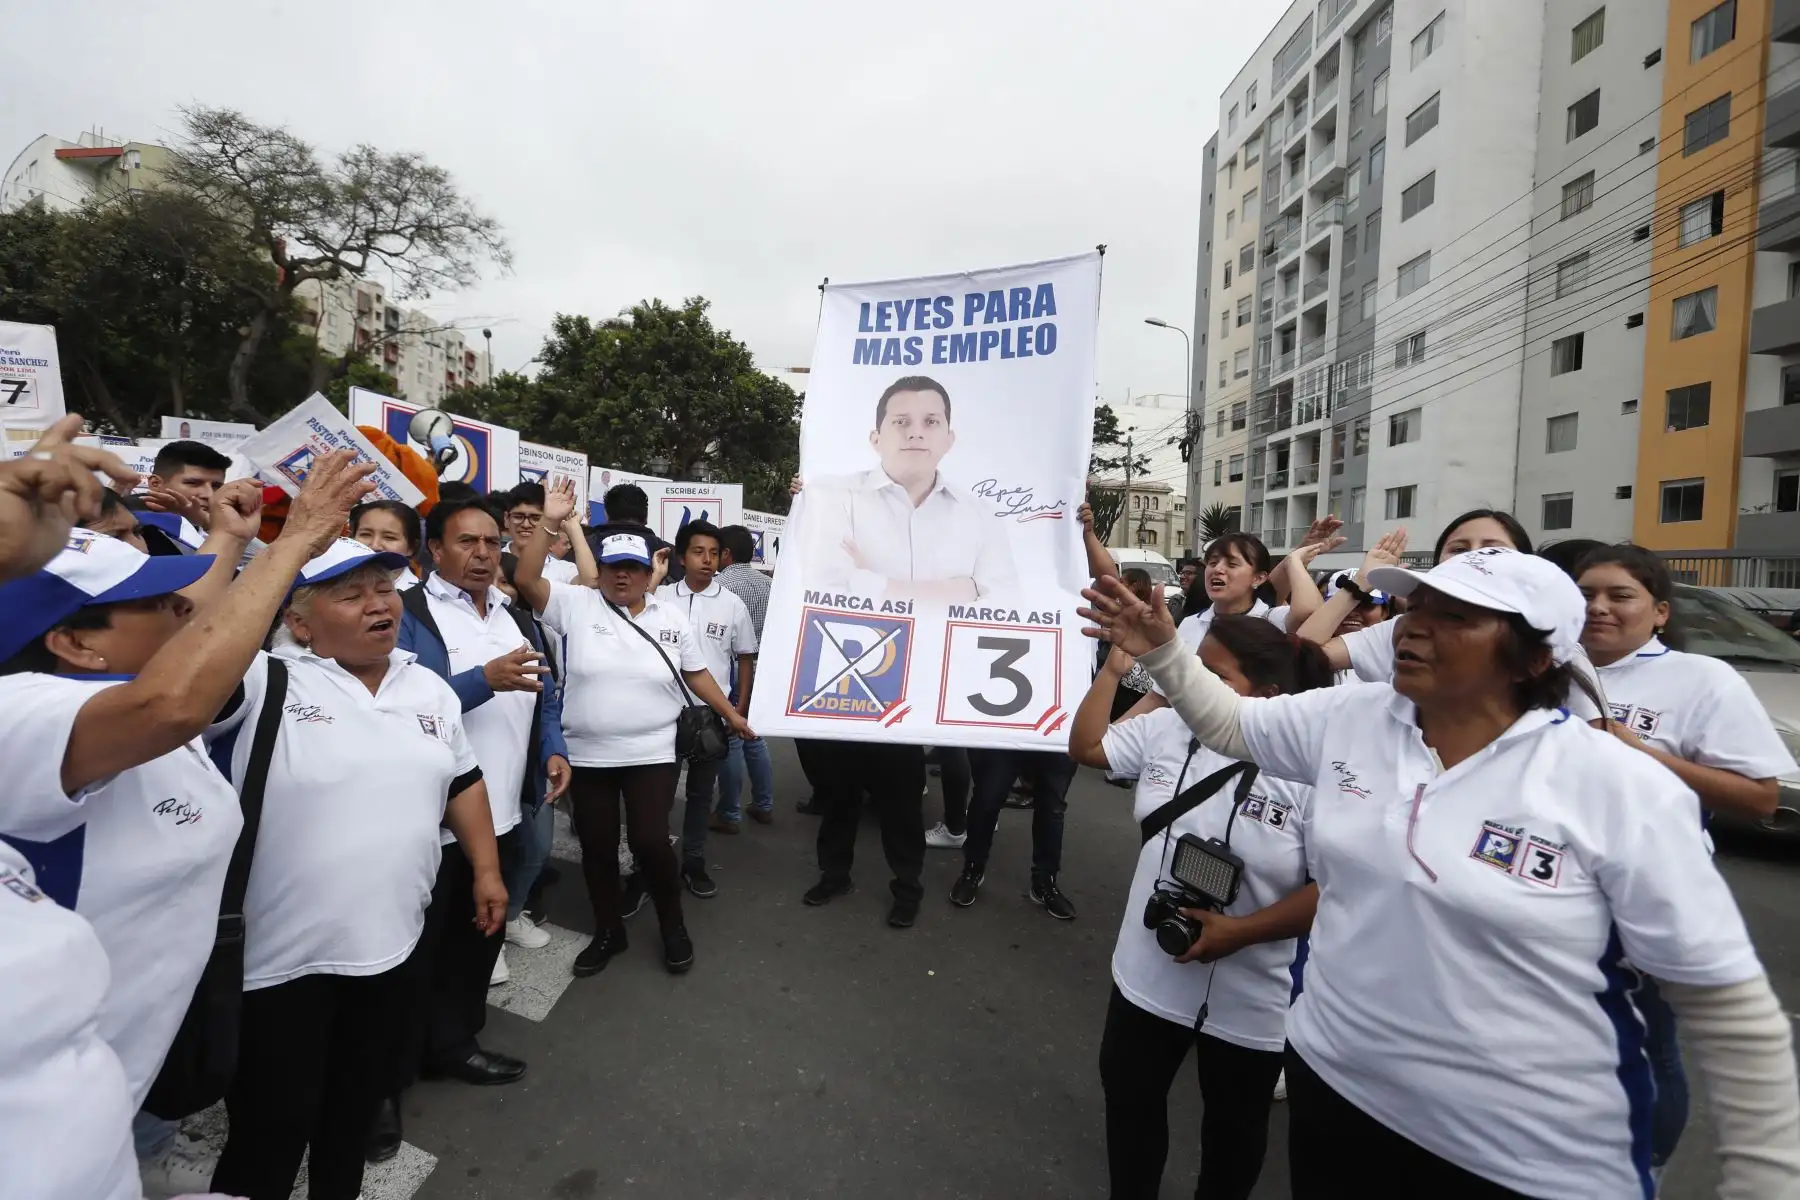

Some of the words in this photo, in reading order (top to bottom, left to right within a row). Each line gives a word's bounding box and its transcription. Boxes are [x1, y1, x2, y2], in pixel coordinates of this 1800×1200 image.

[858, 296, 954, 333] LEYES
[963, 283, 1057, 326] PARA
[853, 336, 924, 366] MAS
[931, 322, 1058, 364] EMPLEO
[8, 357, 49, 368] SANCHEZ
[0, 379, 31, 405] 7
[555, 454, 584, 467] GUPIOC
[665, 487, 697, 495] ESCRIBE
[698, 486, 710, 496] ASÍ
[971, 478, 1034, 503] Pepe
[743, 512, 763, 523] DANIEL
[803, 590, 875, 618] MARCA
[880, 600, 914, 621] ASÍ
[948, 605, 1021, 630] MARCA
[1026, 611, 1061, 632] ASÍ
[672, 634, 678, 643] 3
[966, 635, 1034, 717] 3
[1638, 714, 1654, 731] 3
[1268, 808, 1284, 826] 3
[1530, 849, 1557, 881] 3
